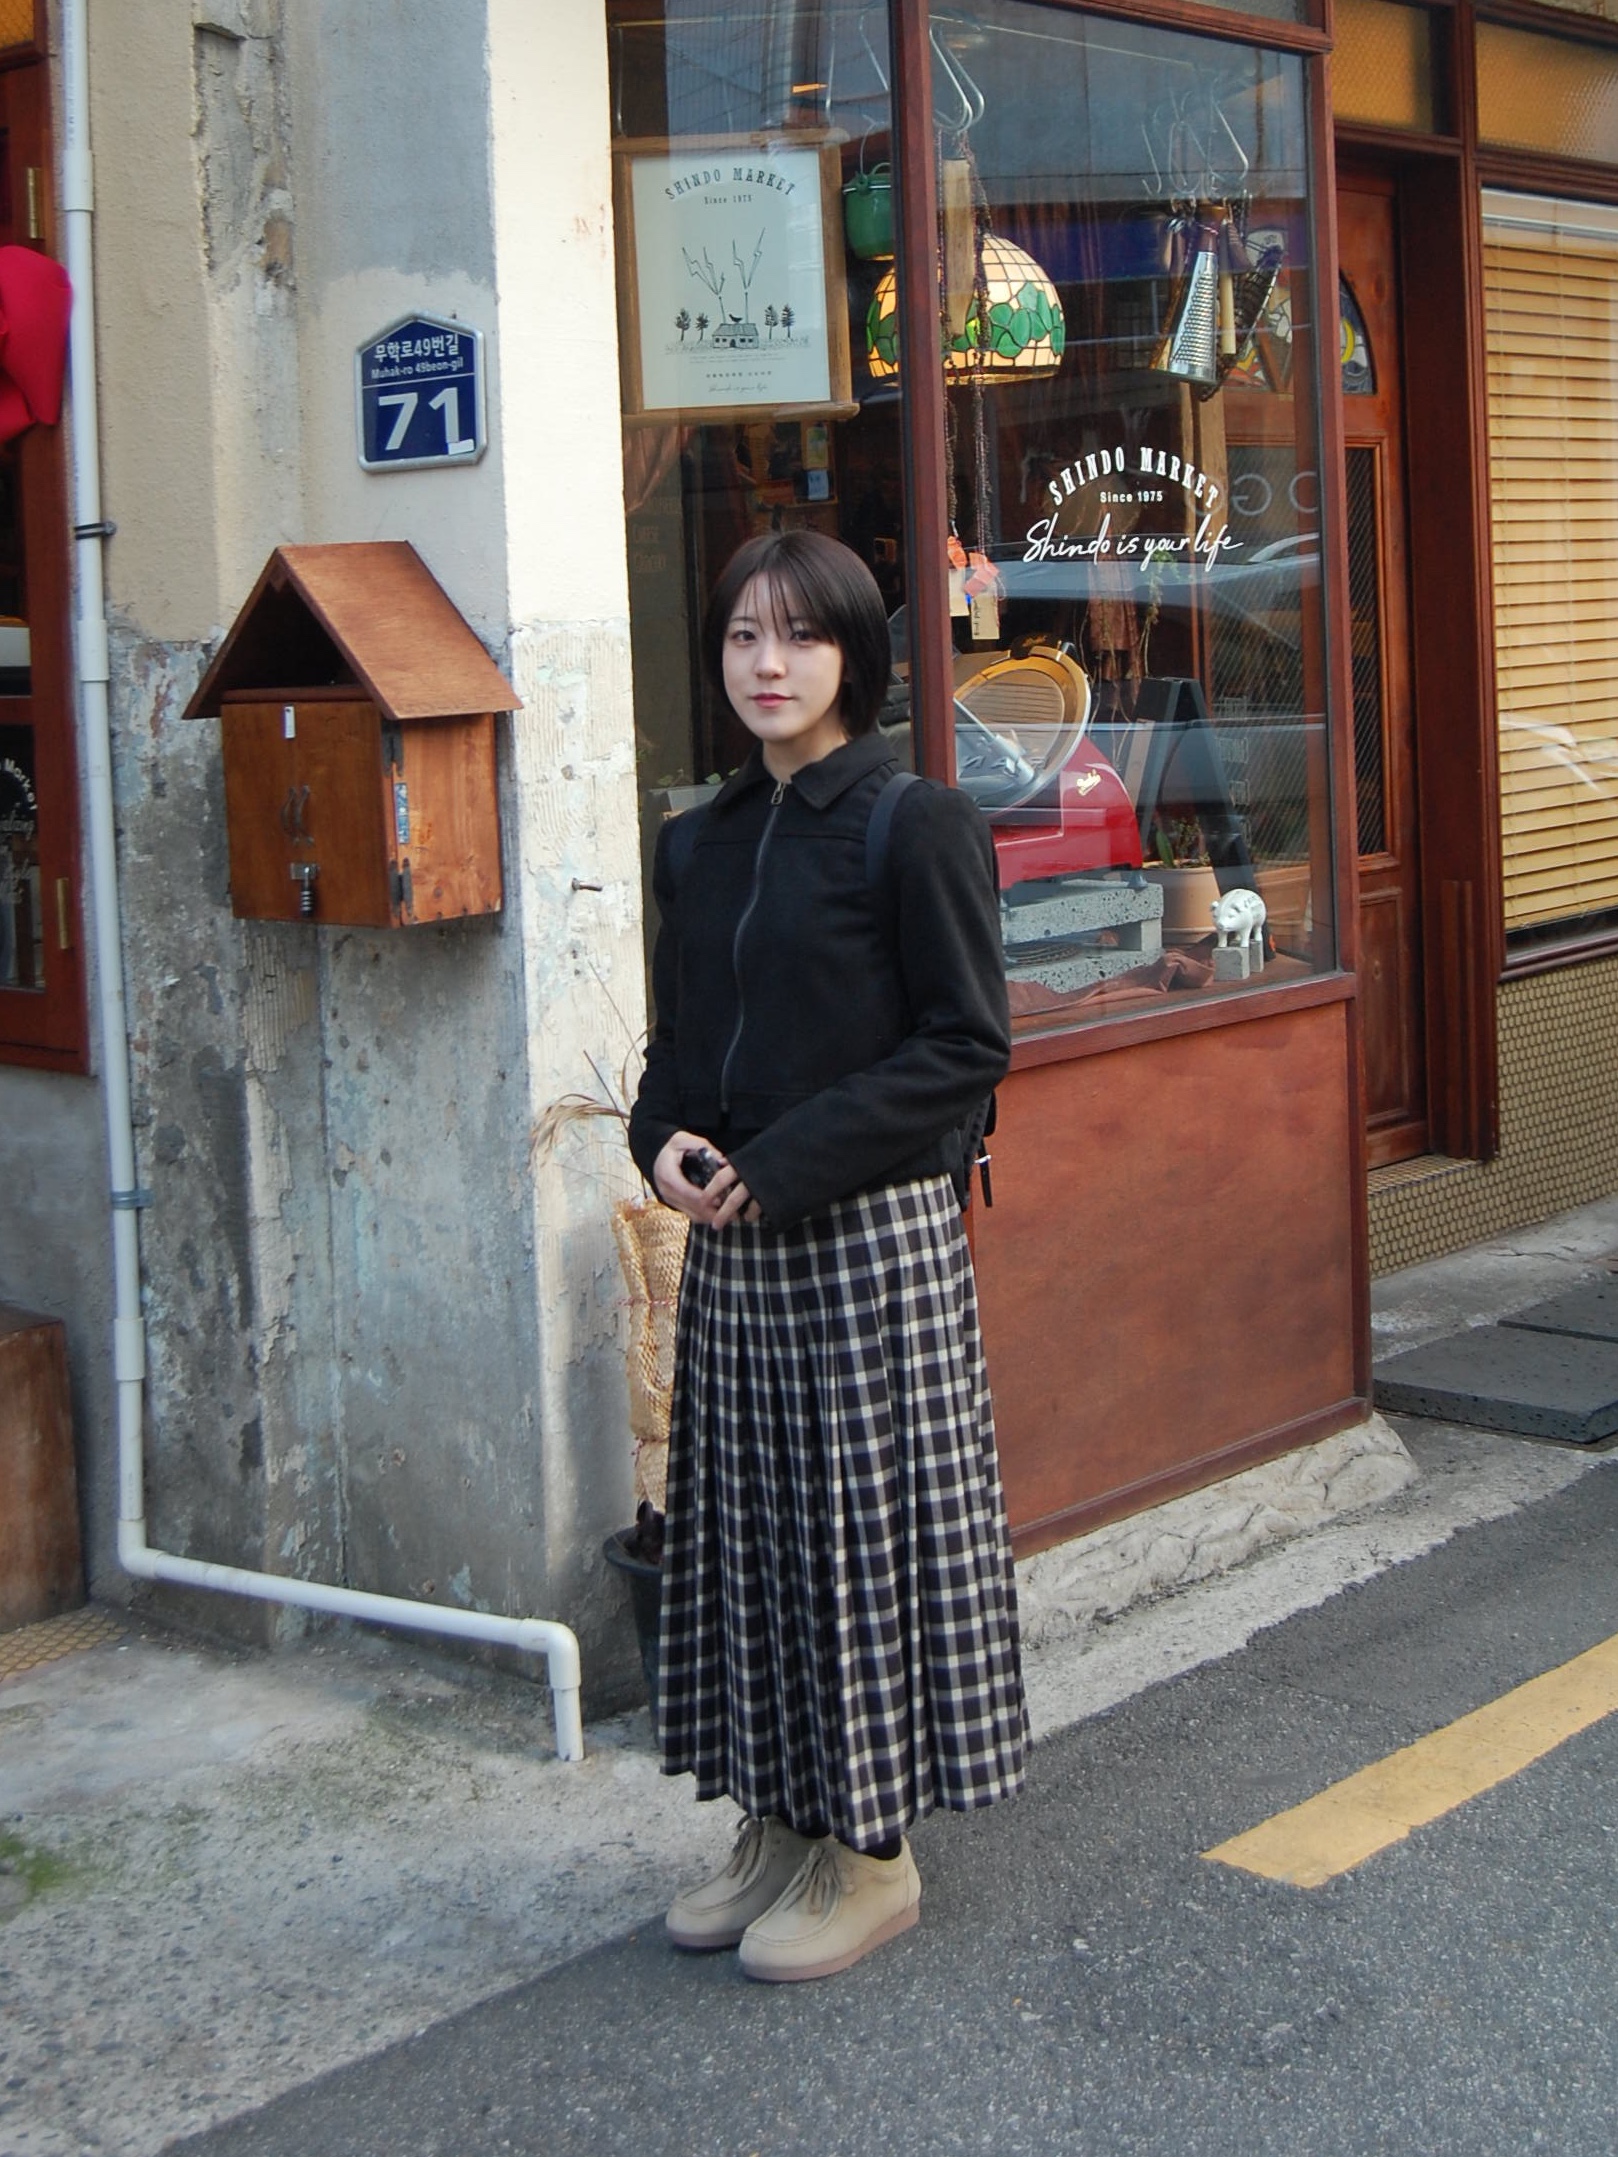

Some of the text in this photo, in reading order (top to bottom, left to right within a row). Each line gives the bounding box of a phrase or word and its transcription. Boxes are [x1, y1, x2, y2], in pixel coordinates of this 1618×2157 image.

[664, 167, 796, 201] SHINDO MARKET
[374, 333, 460, 363] 무학로49번길
[371, 356, 464, 380] Muhak-ro 49beon-gil
[378, 386, 461, 452] 71
[1048, 446, 1219, 509] SHINDO MARKET
[1099, 490, 1164, 504] Since 1975
[1022, 512, 1244, 573] Shindo is your life
